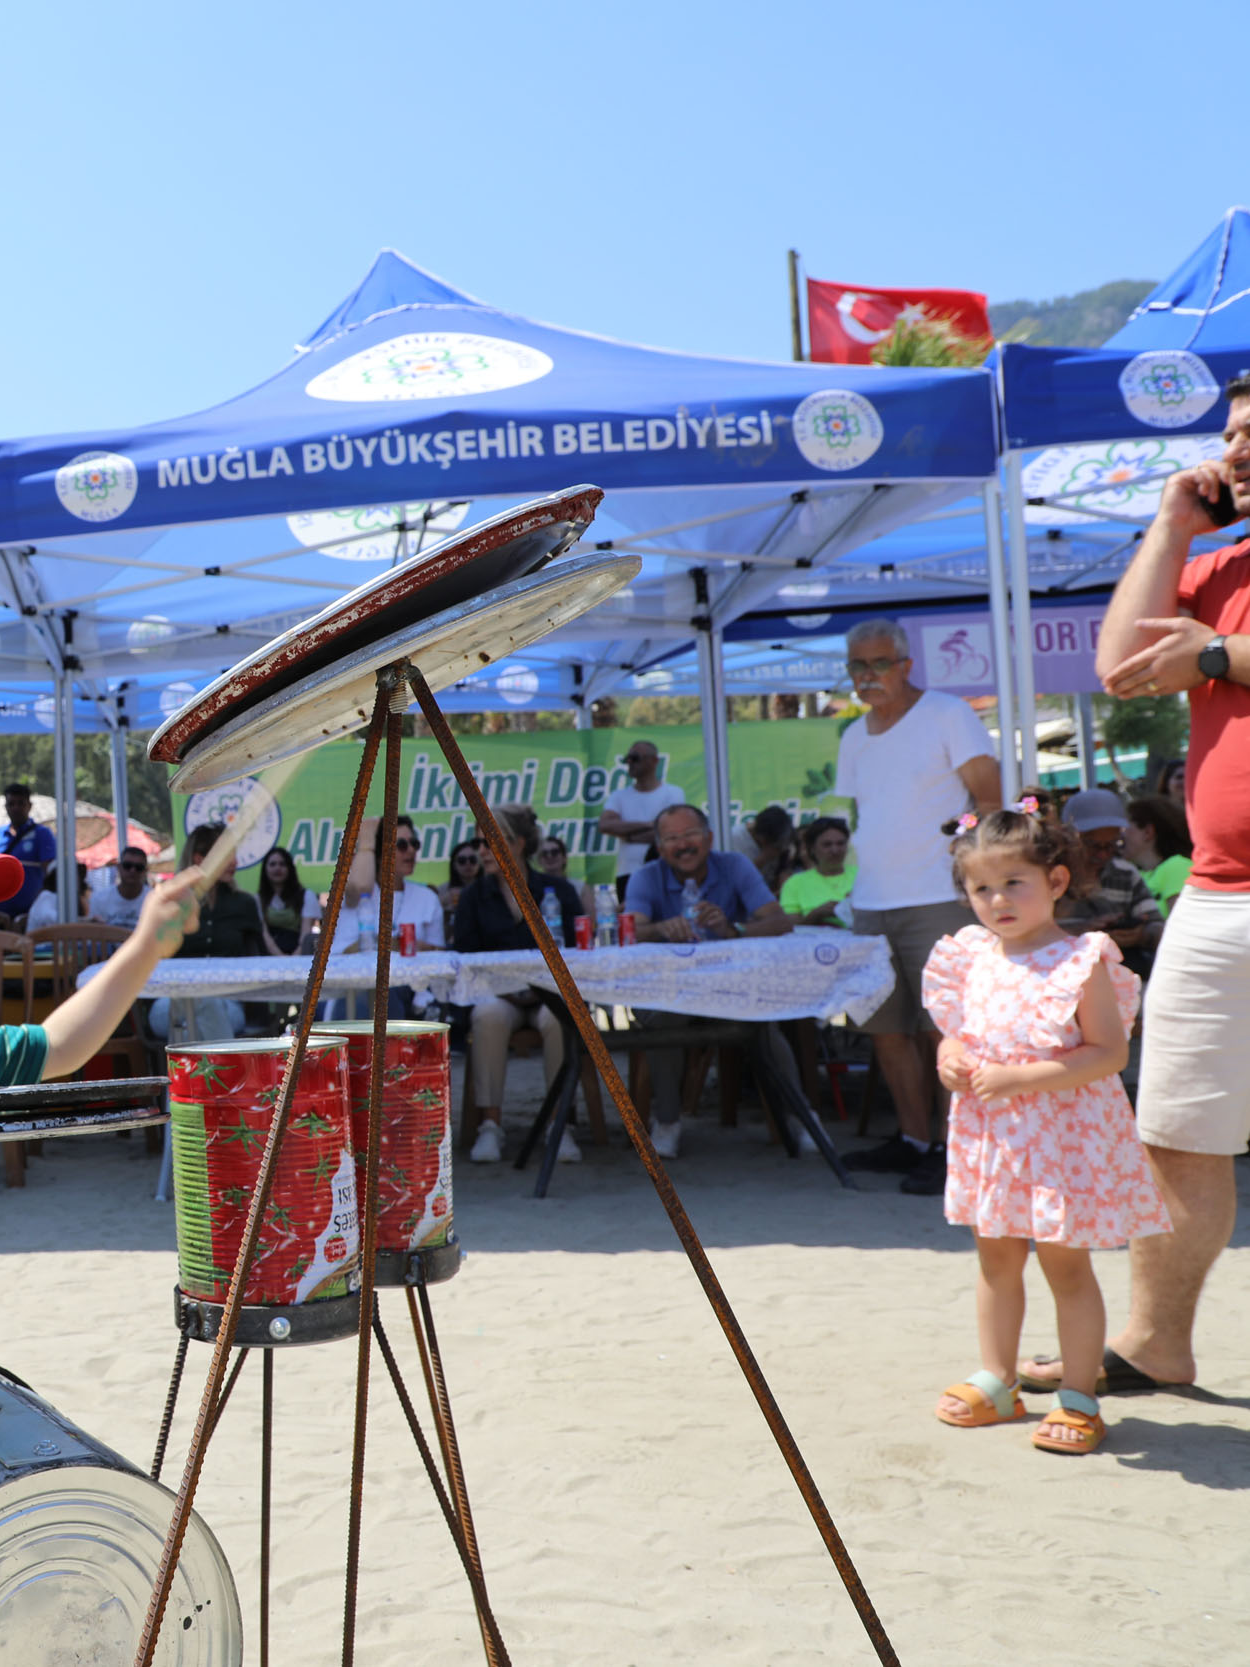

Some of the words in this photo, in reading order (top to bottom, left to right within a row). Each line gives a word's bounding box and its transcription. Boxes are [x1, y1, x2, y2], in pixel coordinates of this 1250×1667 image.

[158, 447, 294, 488] MUĞLA
[303, 420, 545, 475] BÜYÜKŞEHİR
[553, 409, 773, 456] BELEDİYESİ
